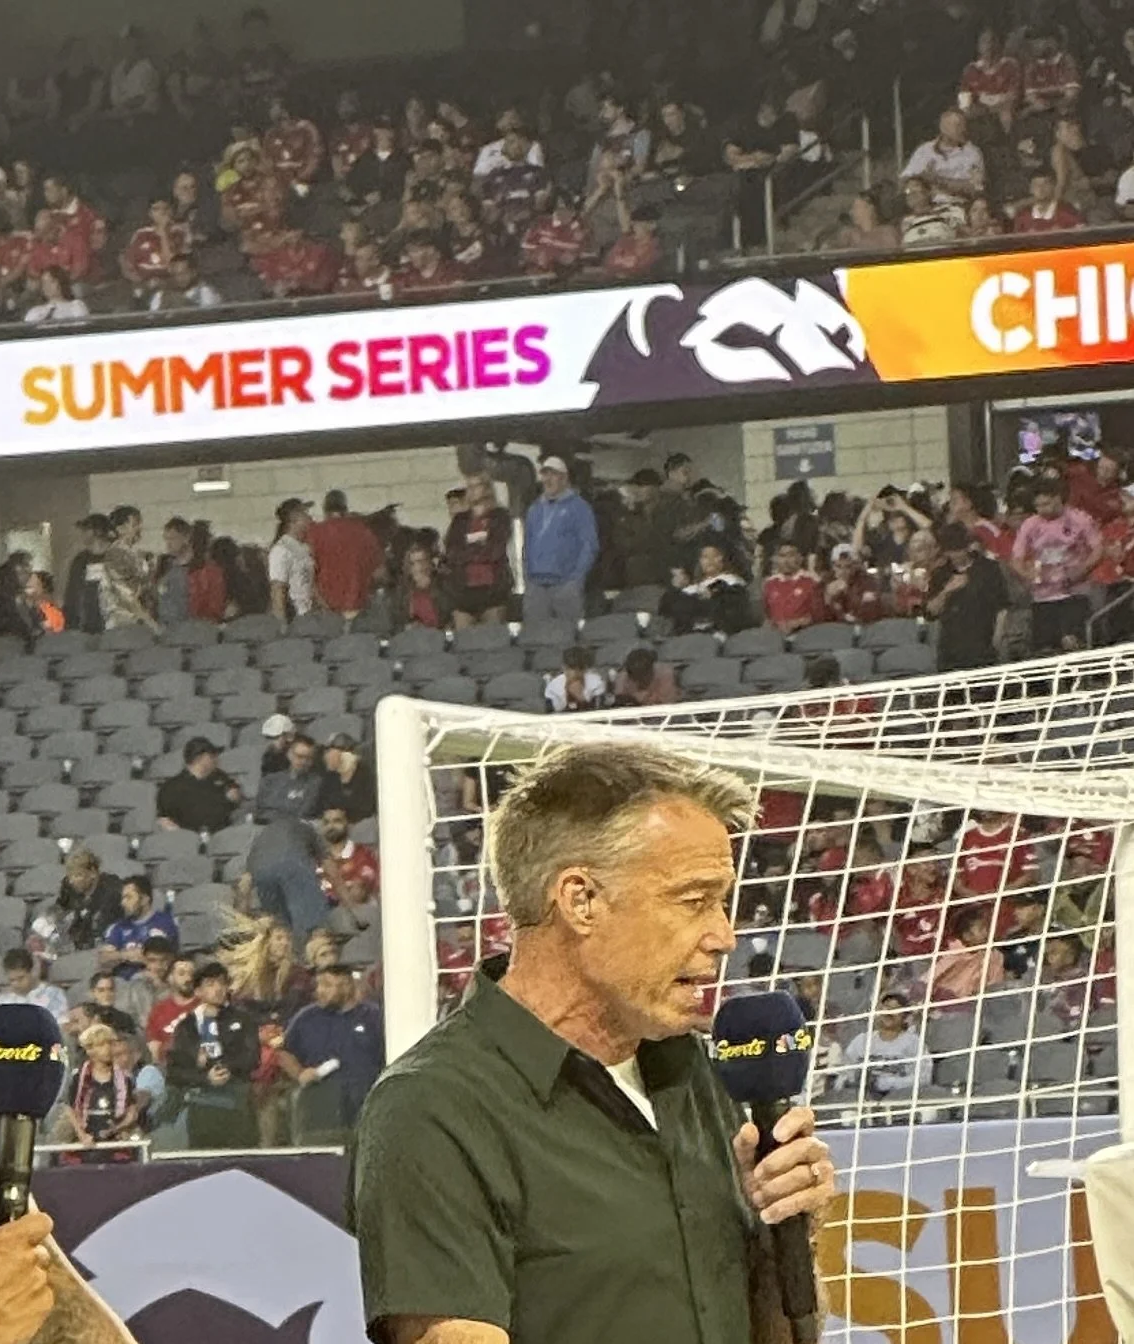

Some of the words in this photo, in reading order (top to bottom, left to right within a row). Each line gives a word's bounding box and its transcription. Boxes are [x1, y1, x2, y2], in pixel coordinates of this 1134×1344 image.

[971, 263, 1134, 355] CHI
[21, 345, 315, 425] SUMMER
[328, 323, 549, 400] SERIES
